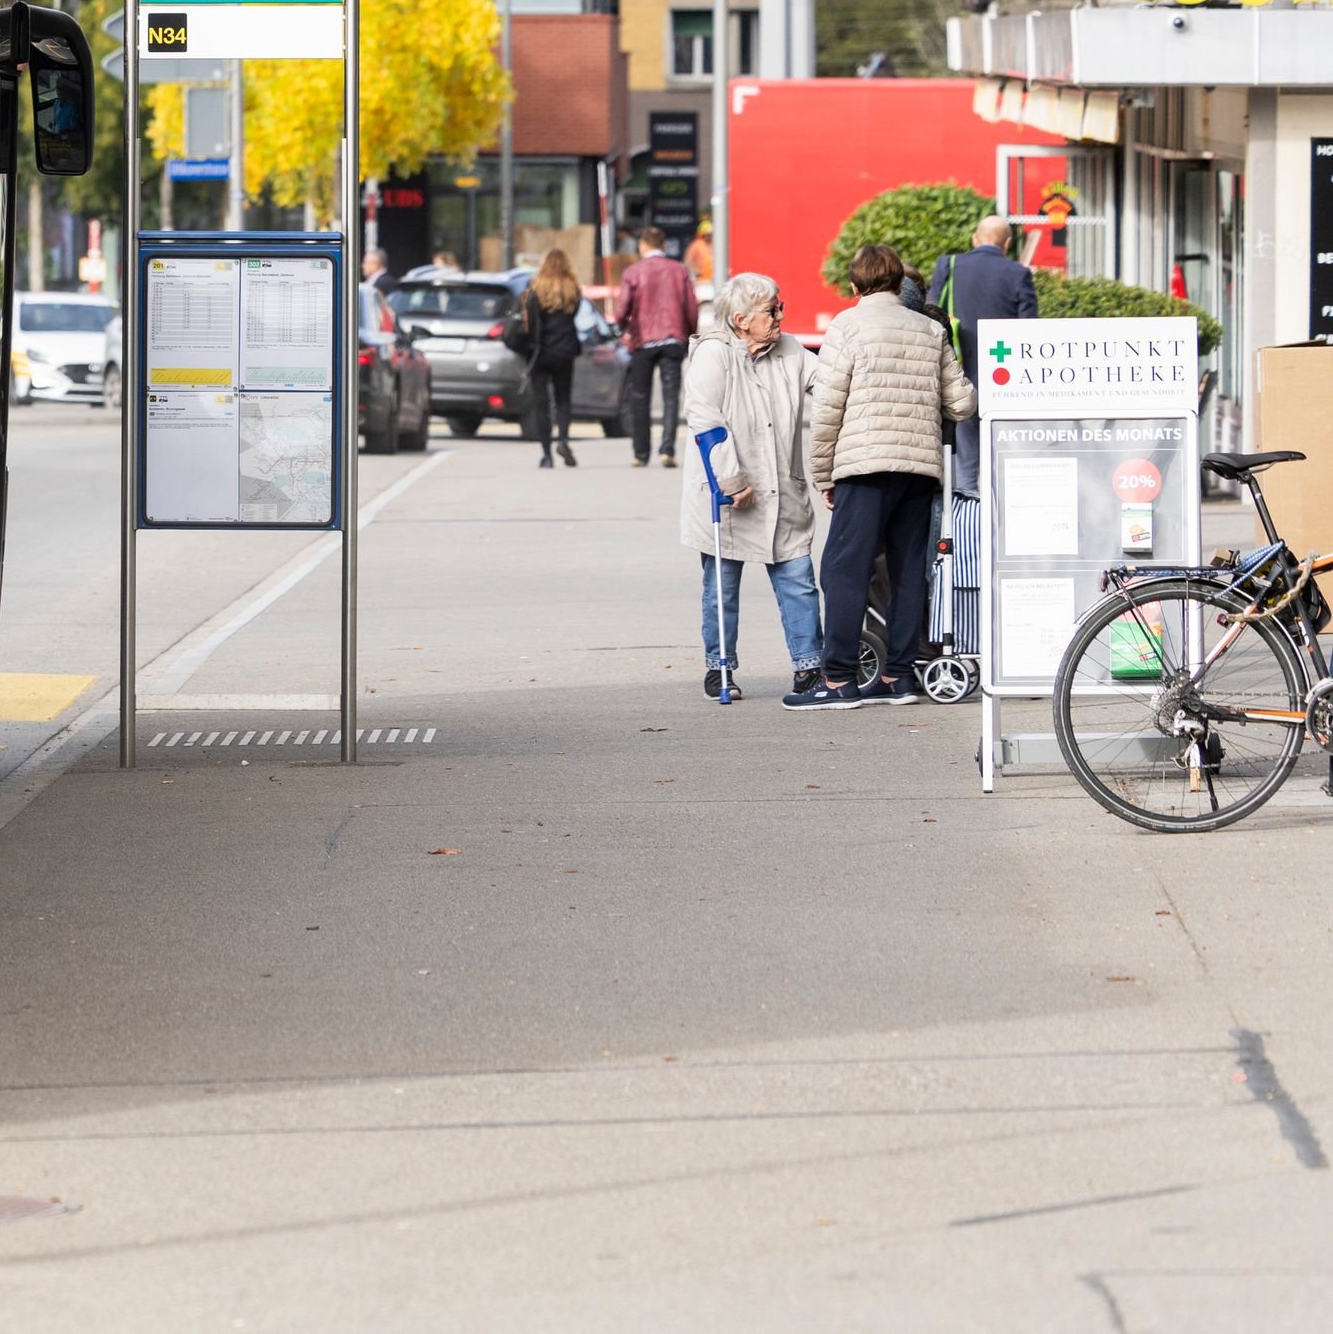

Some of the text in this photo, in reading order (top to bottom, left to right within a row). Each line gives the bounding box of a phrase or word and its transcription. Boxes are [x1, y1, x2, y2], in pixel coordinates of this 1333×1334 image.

[148, 27, 187, 45] N34
[1019, 340, 1185, 359] ROTPUNKT
[1019, 366, 1185, 384] APOTHEKE
[992, 390, 1034, 398] FÜHREND
[1048, 389, 1106, 398] MEDIKAMENT
[1109, 389, 1128, 397] UND
[997, 427, 1183, 443] AKTIONEN DES MONATS
[1118, 474, 1156, 489] 20%
